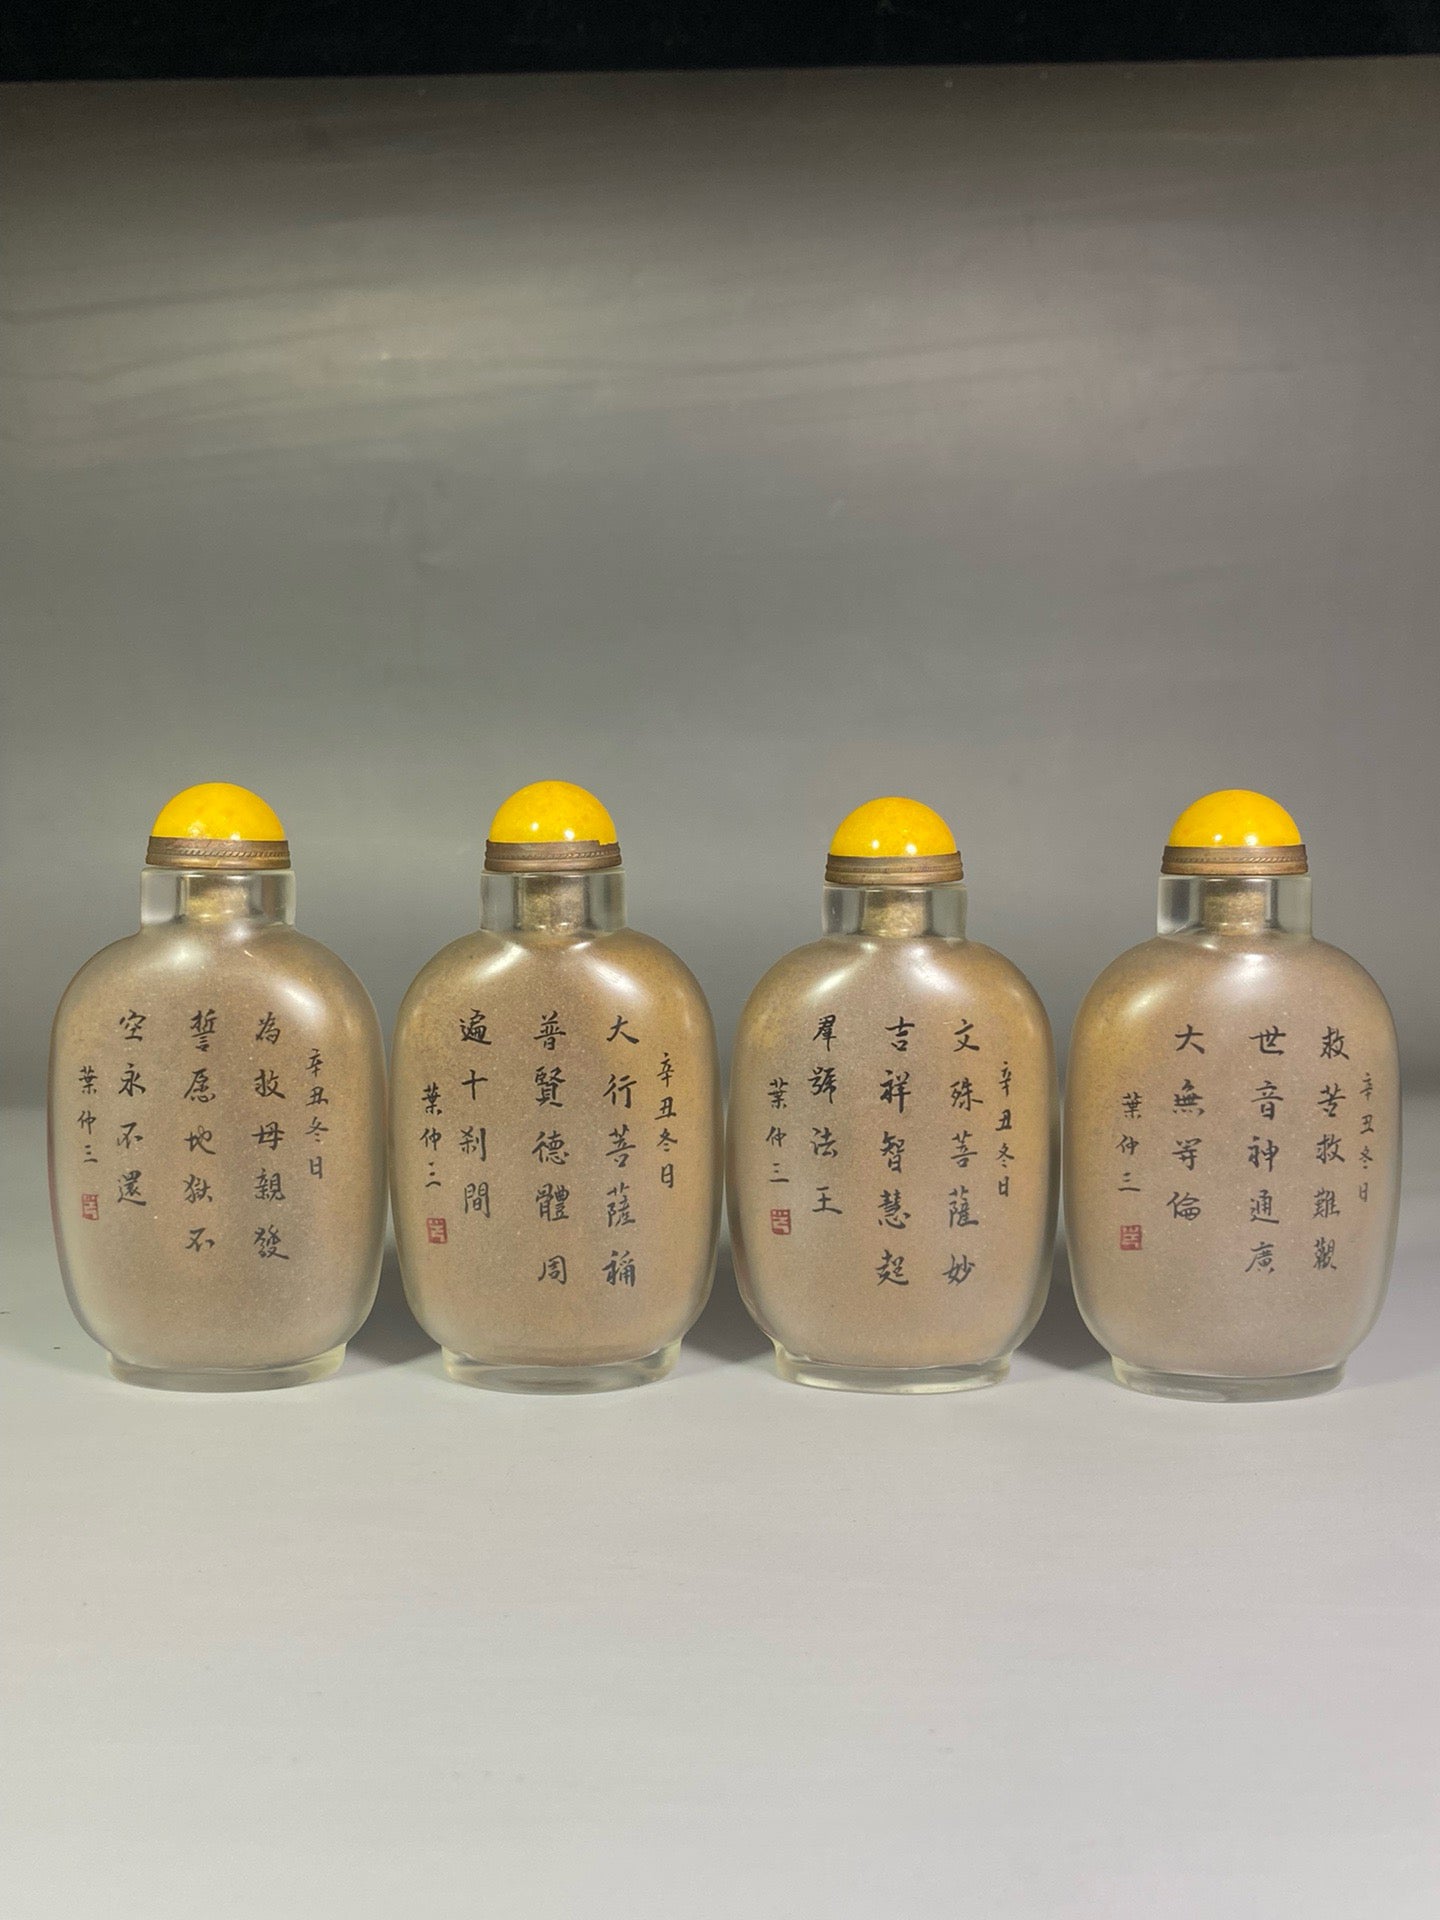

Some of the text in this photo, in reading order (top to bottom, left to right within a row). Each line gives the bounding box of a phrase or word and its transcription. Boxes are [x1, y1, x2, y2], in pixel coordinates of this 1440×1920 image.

[77, 1065, 99, 1164] 葉仲三
[116, 1010, 147, 1206] 空永不還
[252, 1011, 290, 1260] 為救母親發
[304, 1048, 329, 1179] 辛丑冬日
[420, 1082, 442, 1188] 葉仲三
[532, 1010, 570, 1286] 普賢德體周
[654, 1052, 678, 1189] 辛丑冬日
[765, 1077, 791, 1184] 葉仲三
[942, 1019, 984, 1286] 文殊菩薩妙
[995, 1061, 1015, 1198] 辛丑冬日
[1116, 1091, 1142, 1193] 葉仲三
[1166, 1024, 1206, 1221] 大無等倫
[1245, 1025, 1287, 1274] 世音神通廣
[1311, 1026, 1350, 1271] 救苦救難觀
[1358, 1072, 1374, 1203] 辛丑冬日
